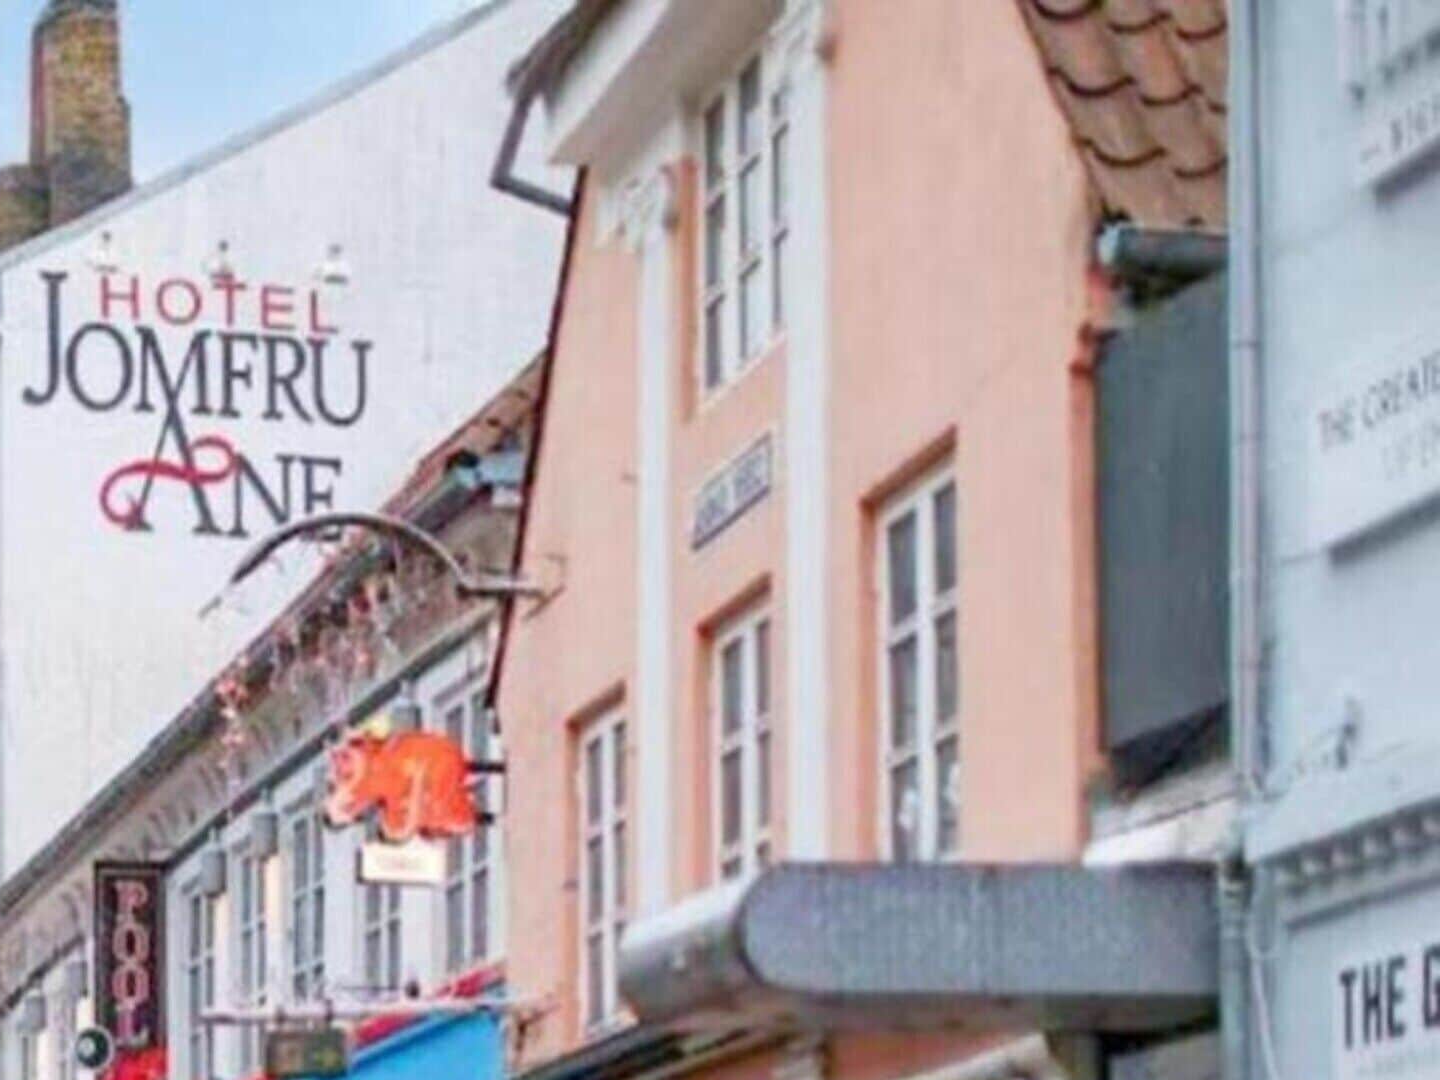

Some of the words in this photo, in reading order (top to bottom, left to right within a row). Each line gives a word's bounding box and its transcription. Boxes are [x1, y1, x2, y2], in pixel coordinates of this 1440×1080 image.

[22, 269, 373, 428] JOMFRU
[99, 271, 339, 335] HOTEL
[100, 403, 343, 542] ANE
[112, 880, 151, 1050] POOL
[1338, 954, 1407, 1051] THE
